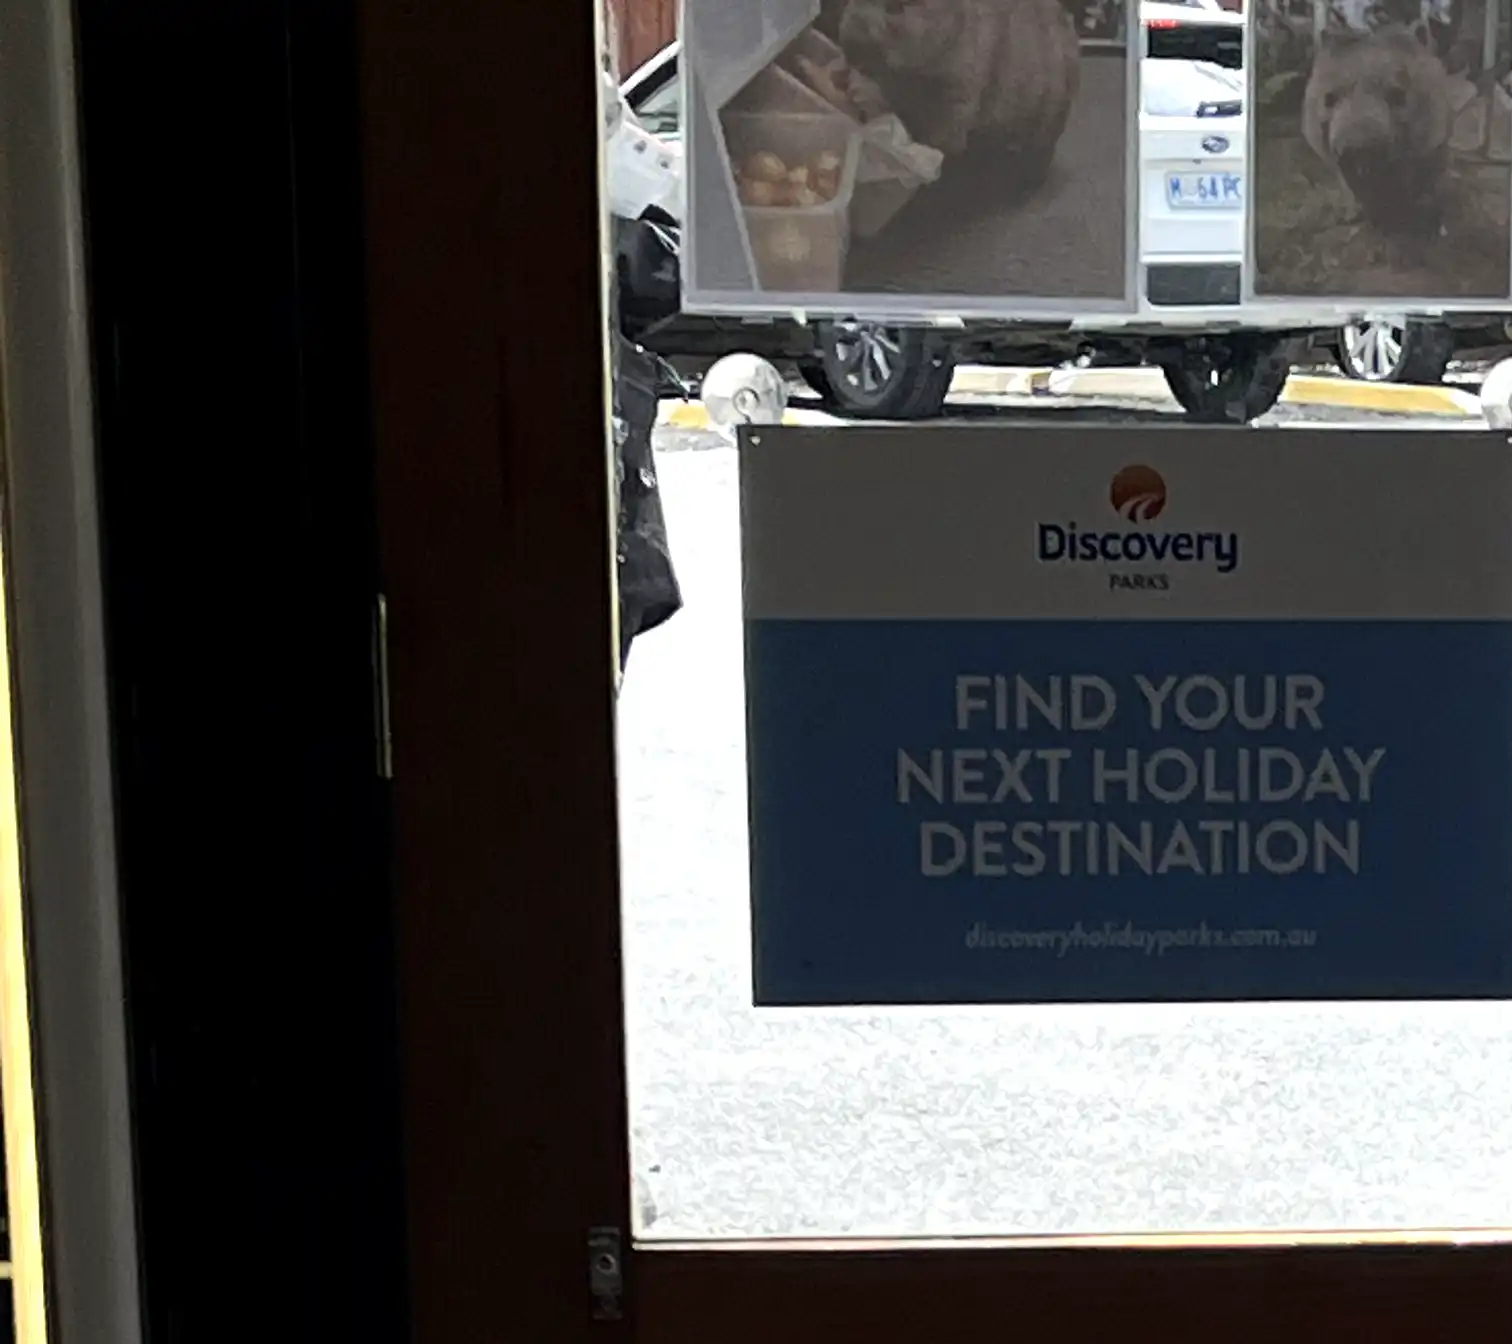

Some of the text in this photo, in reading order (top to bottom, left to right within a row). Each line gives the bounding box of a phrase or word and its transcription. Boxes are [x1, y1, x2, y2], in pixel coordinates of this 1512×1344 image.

[1038, 521, 1238, 573] Discovery
[1109, 573, 1170, 590] PARKS
[954, 673, 1326, 731] FIND YOUR
[896, 746, 1387, 804] NEXT HOLIDAY
[919, 818, 1361, 877] DESTINATION
